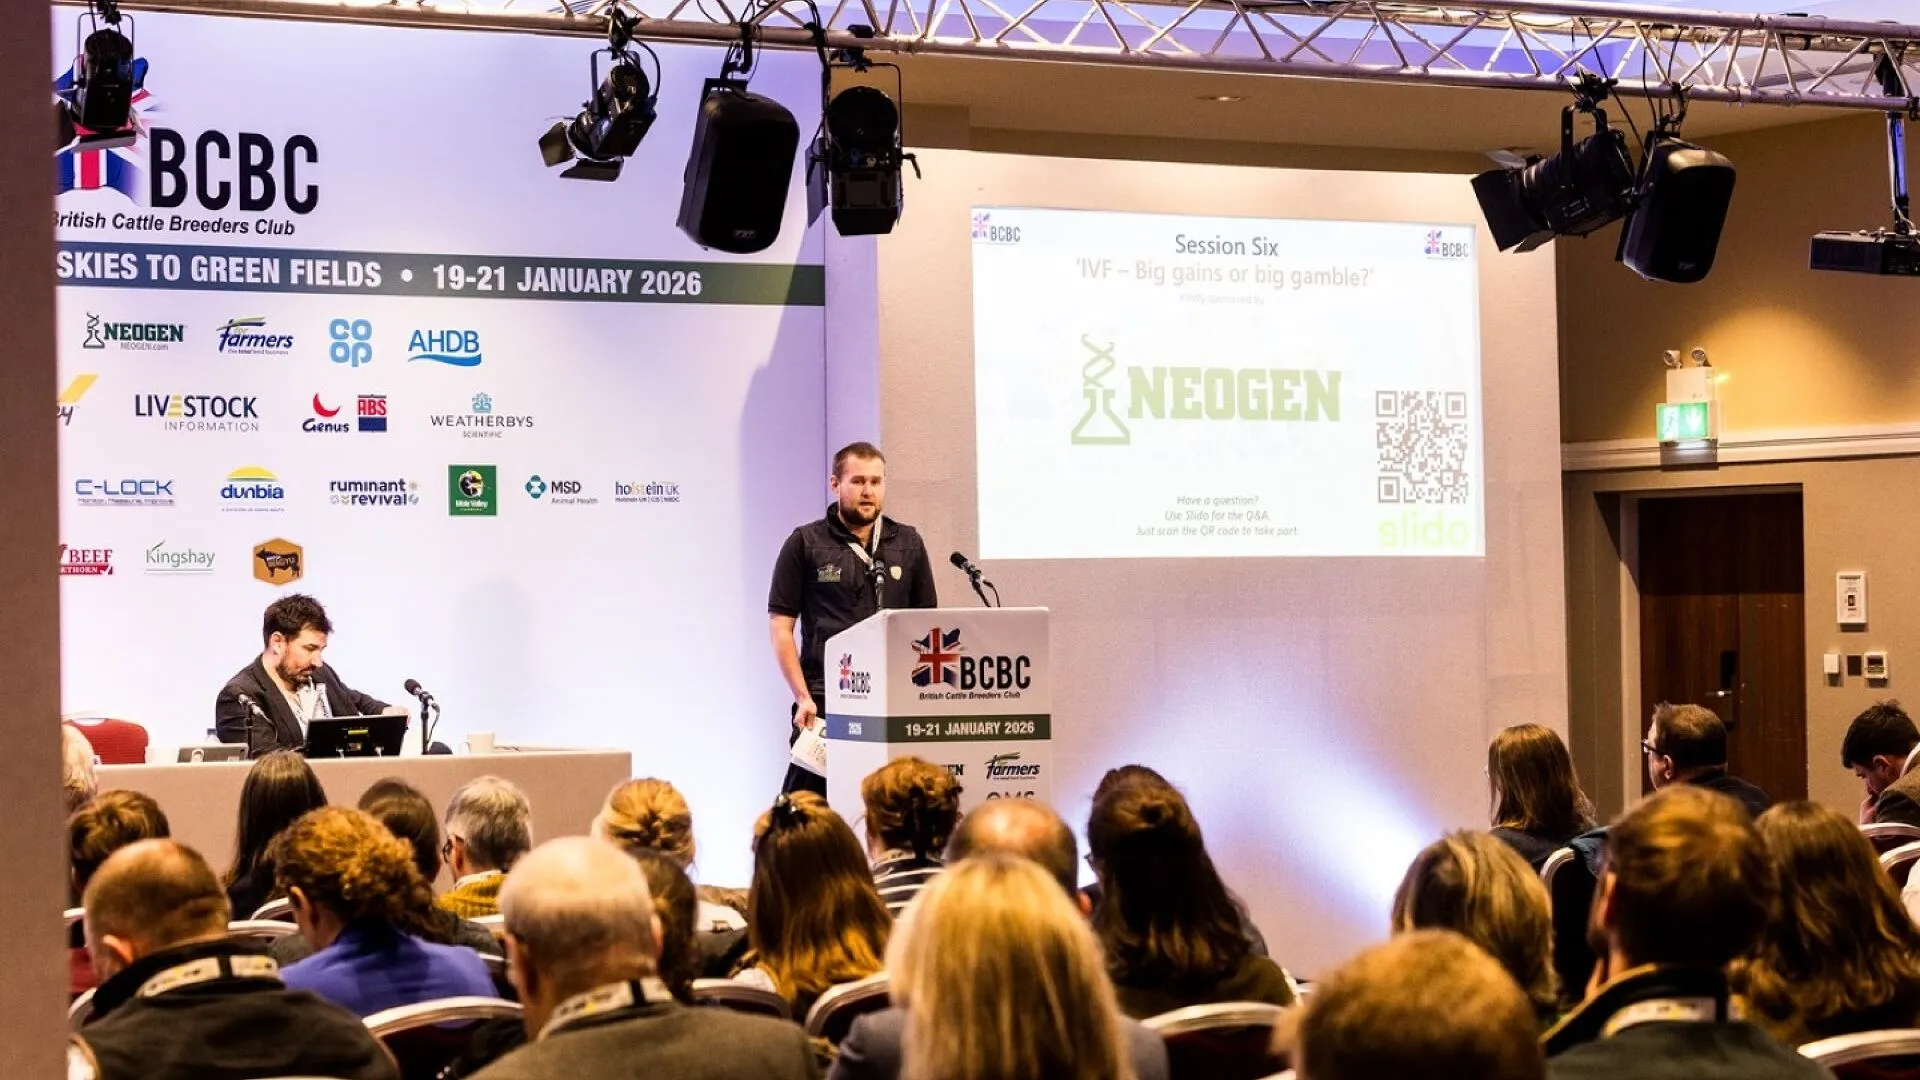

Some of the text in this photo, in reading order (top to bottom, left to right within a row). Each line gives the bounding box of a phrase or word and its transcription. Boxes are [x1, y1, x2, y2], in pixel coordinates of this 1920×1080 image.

[150, 127, 319, 215] BCBC
[112, 212, 164, 231] Cattle
[169, 215, 249, 234] Breeders
[255, 218, 295, 235] Club
[990, 226, 1021, 243] BCBC
[1175, 233, 1280, 257] Session Six
[1442, 242, 1469, 258] BCBC
[56, 251, 703, 296] SKIES TO GREEN FIELDS 19-21 JANUARY 2026
[1135, 259, 1166, 287] Big
[1172, 261, 1223, 287] gains
[1229, 266, 1249, 283] or
[1255, 264, 1285, 290] big
[103, 322, 184, 342] NEOGEN
[407, 329, 481, 354] AHDB
[1127, 366, 1342, 422] NEOGEN
[135, 394, 260, 419] LIVESTOCK
[357, 398, 387, 416] ABS
[164, 421, 260, 433] INFORMATION
[302, 417, 350, 433] Genus
[430, 414, 534, 428] WEATHERBYS
[75, 479, 173, 496] C-LOCK
[220, 483, 285, 500] dunbia
[330, 477, 406, 492] ruminant
[551, 480, 582, 495] MSD
[351, 493, 408, 506] revival
[1176, 495, 1260, 507] Have a question?
[1165, 510, 1183, 521] Use
[1186, 510, 1210, 521] Slido
[1211, 510, 1225, 523] for
[1228, 510, 1244, 521] the
[1135, 526, 1155, 537] Just
[1157, 528, 1179, 537] scan
[1181, 525, 1198, 536] the
[1200, 525, 1215, 537] QR
[1217, 525, 1240, 537] code
[1242, 526, 1252, 537] to
[1254, 525, 1274, 537] take
[1378, 507, 1471, 548] slido
[69, 549, 113, 563] BEEF
[146, 547, 216, 568] Kingshay
[960, 654, 1032, 690] BCBC
[919, 690, 1021, 700] British Cattle Breeders Club
[905, 720, 1036, 737] 19-21 JANUARY 2026
